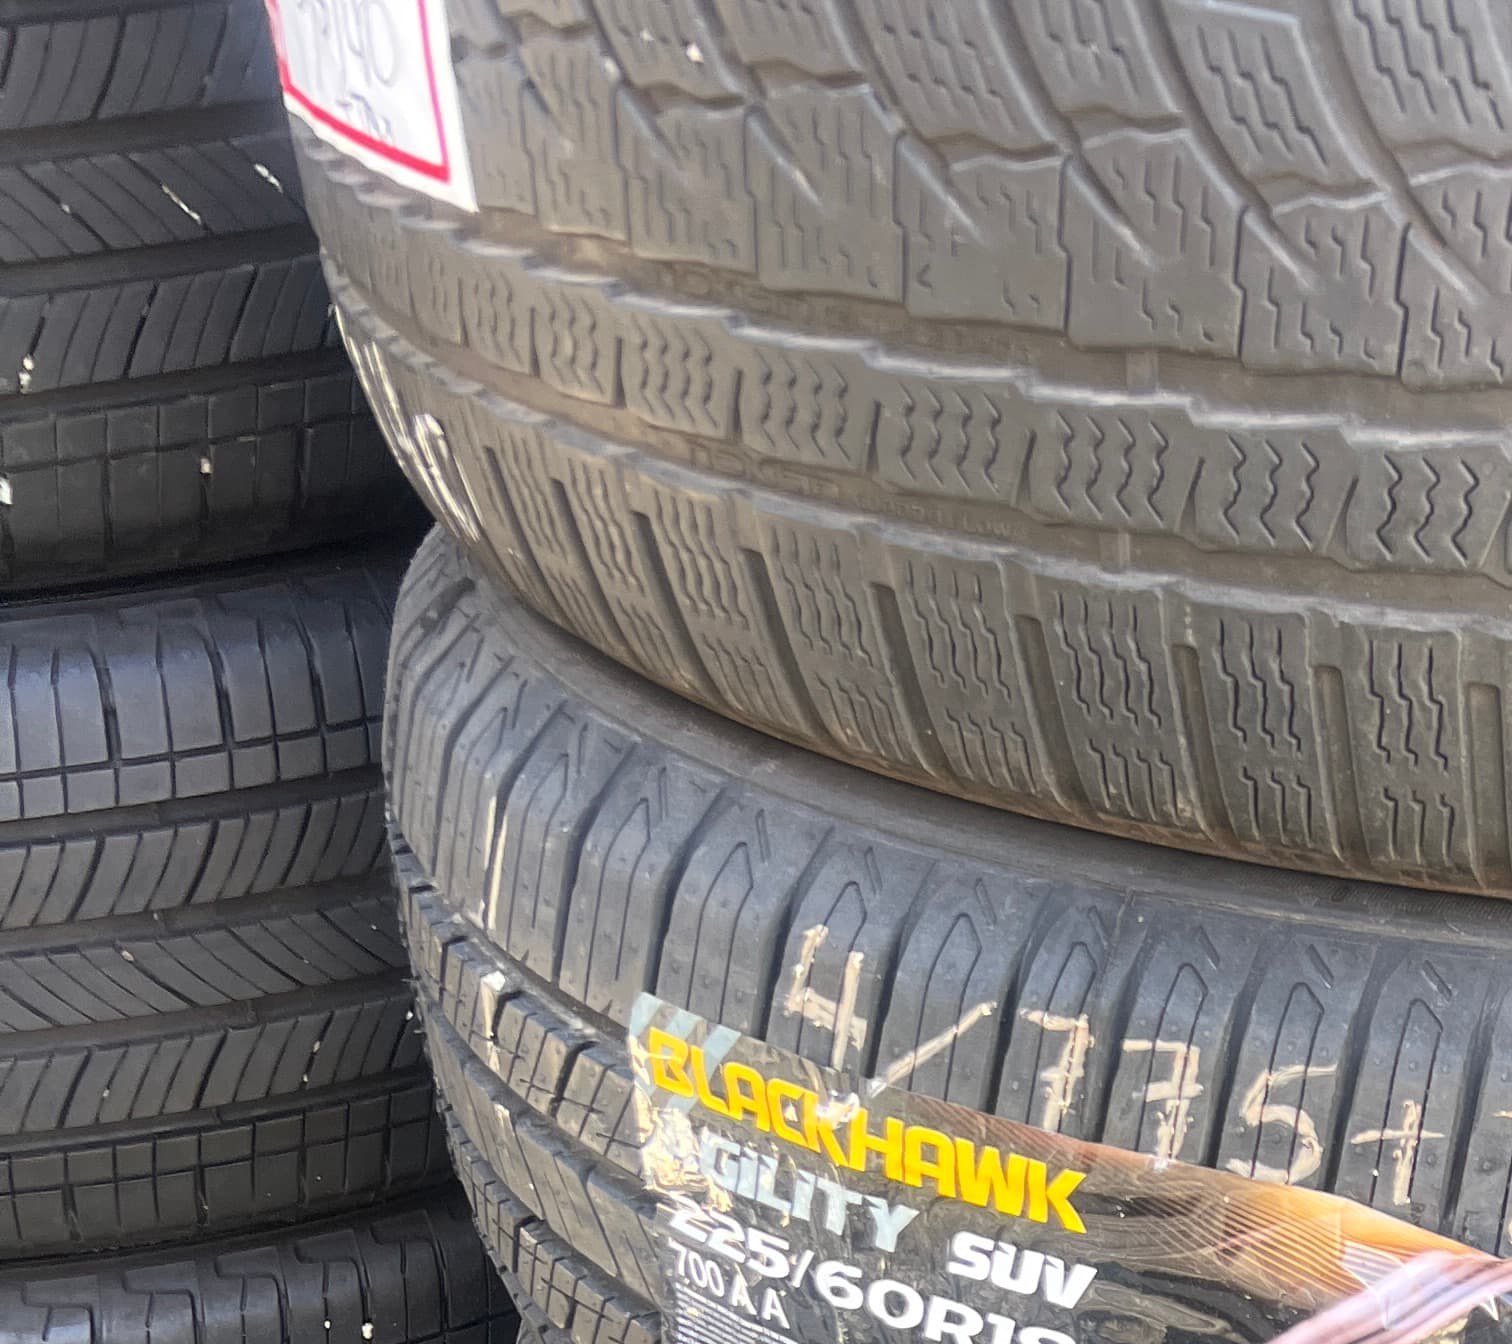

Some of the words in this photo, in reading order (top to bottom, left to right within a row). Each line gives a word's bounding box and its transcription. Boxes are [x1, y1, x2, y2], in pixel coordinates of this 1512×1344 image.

[649, 1026, 1087, 1233] BLACKHAWK
[662, 1116, 919, 1253] GILITY
[947, 1231, 1098, 1309] SUV
[668, 1237, 725, 1298] 700
[761, 1288, 791, 1330] A
